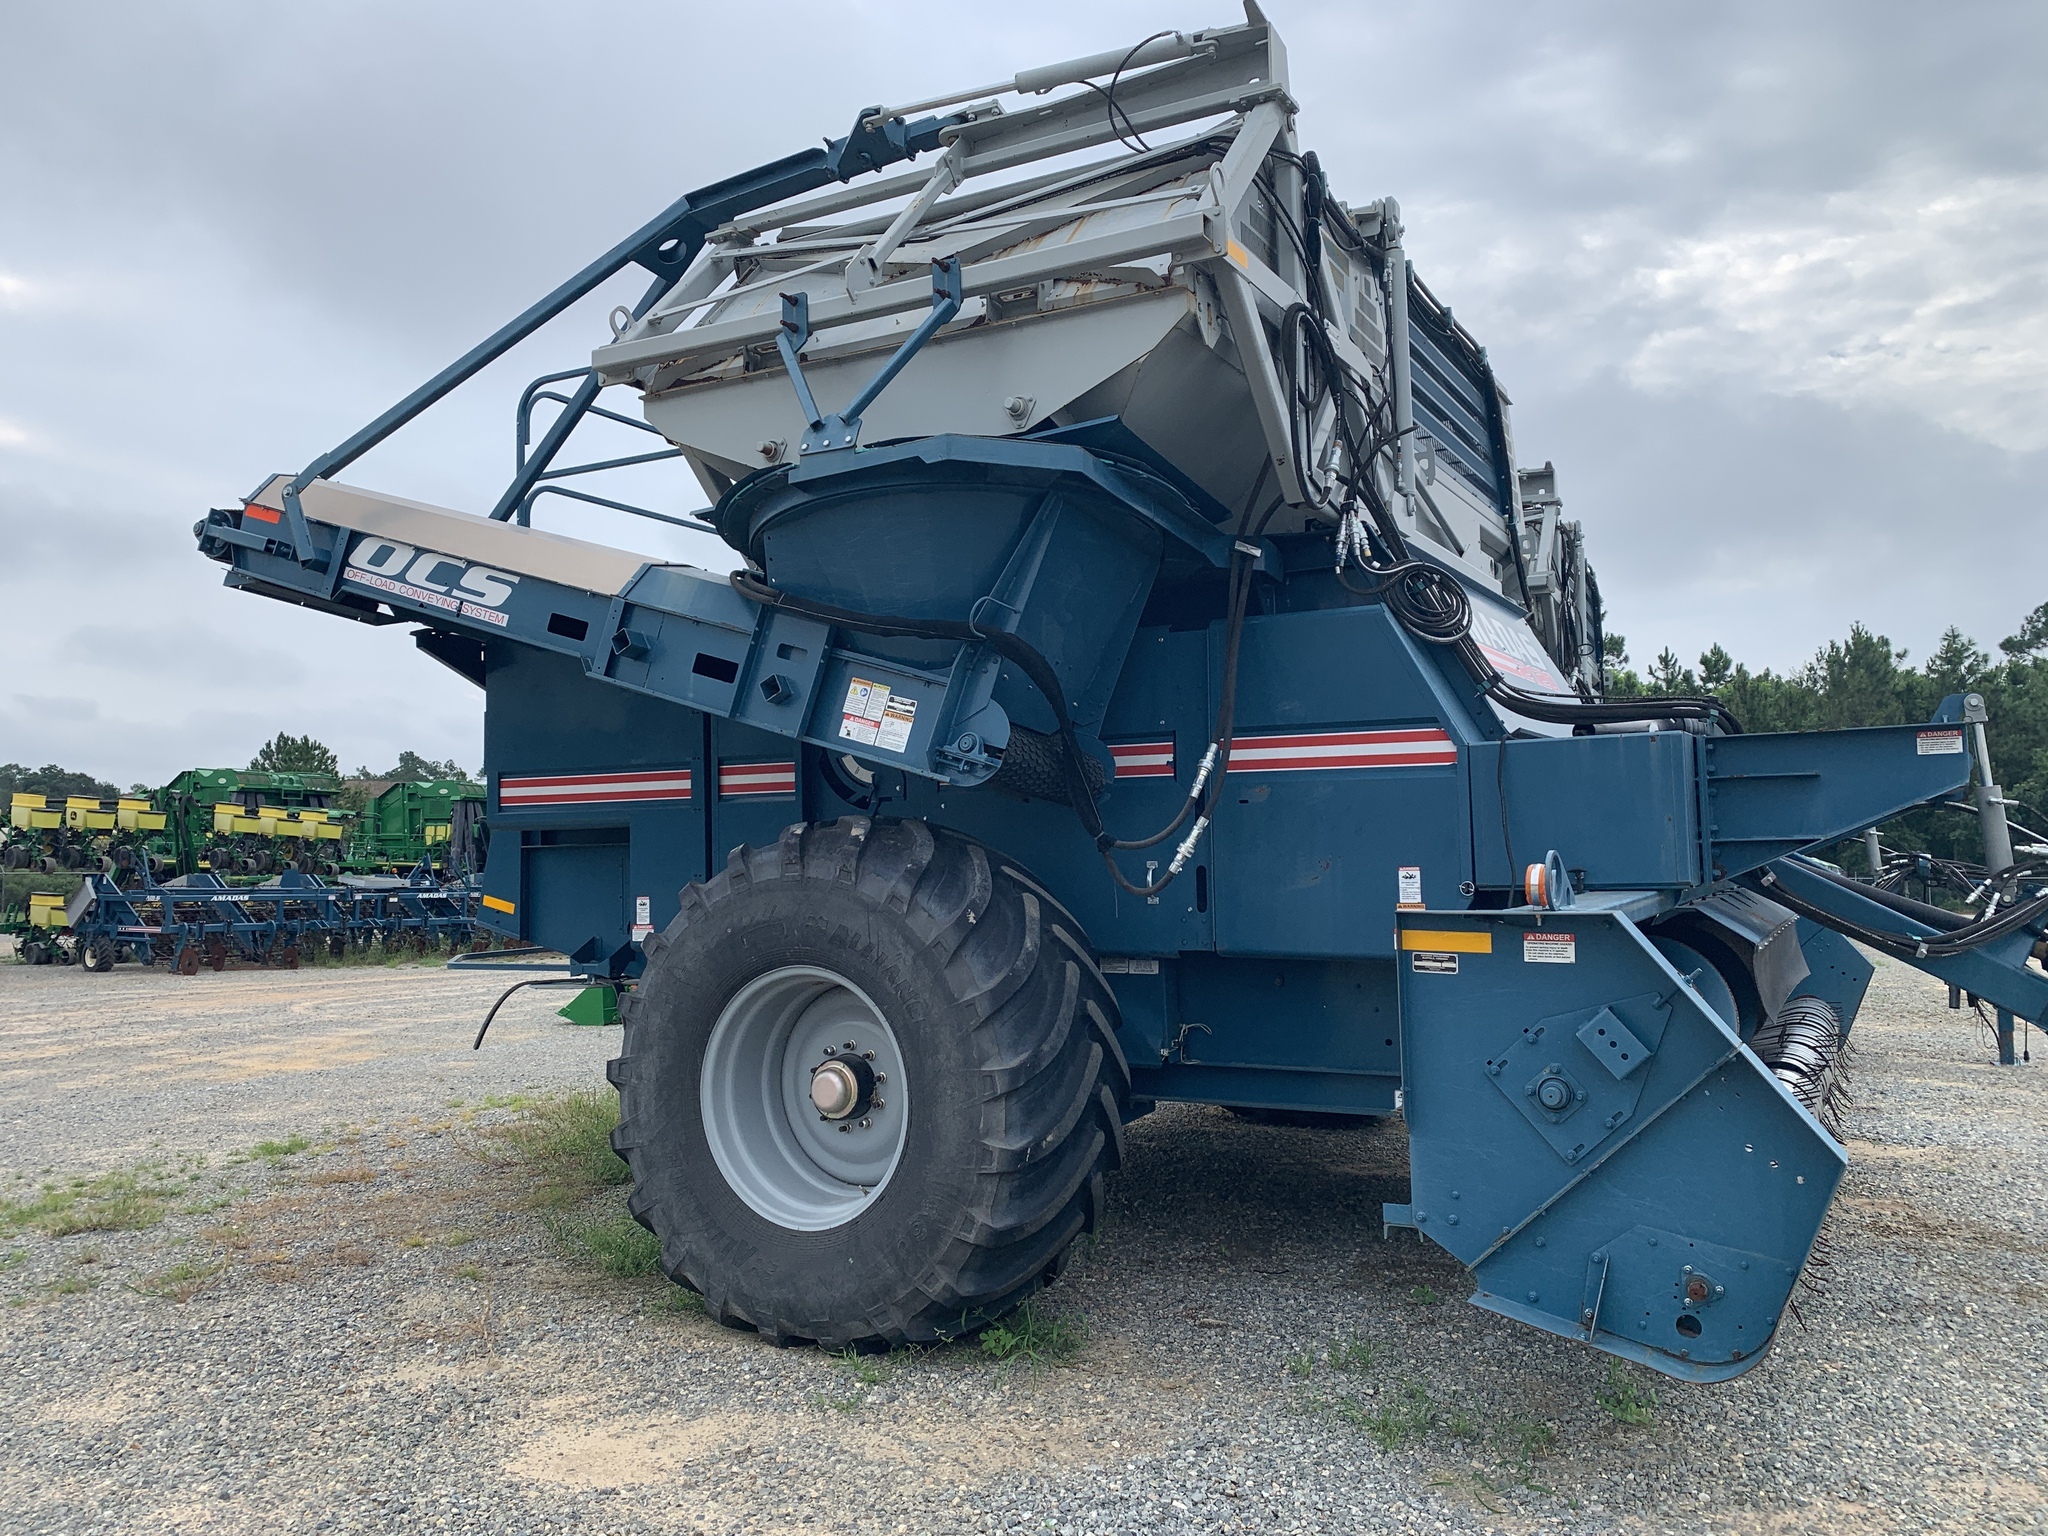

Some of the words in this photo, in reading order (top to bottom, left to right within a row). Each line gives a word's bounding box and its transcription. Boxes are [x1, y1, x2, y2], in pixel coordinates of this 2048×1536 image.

[348, 536, 521, 607] OCS
[346, 569, 396, 591] OFF-LOAD
[399, 584, 460, 611] CONVEYING
[461, 604, 505, 625] SYSTEM
[854, 717, 875, 726] DANGER
[890, 712, 913, 722] WARNING
[1535, 933, 1571, 941] DANGER
